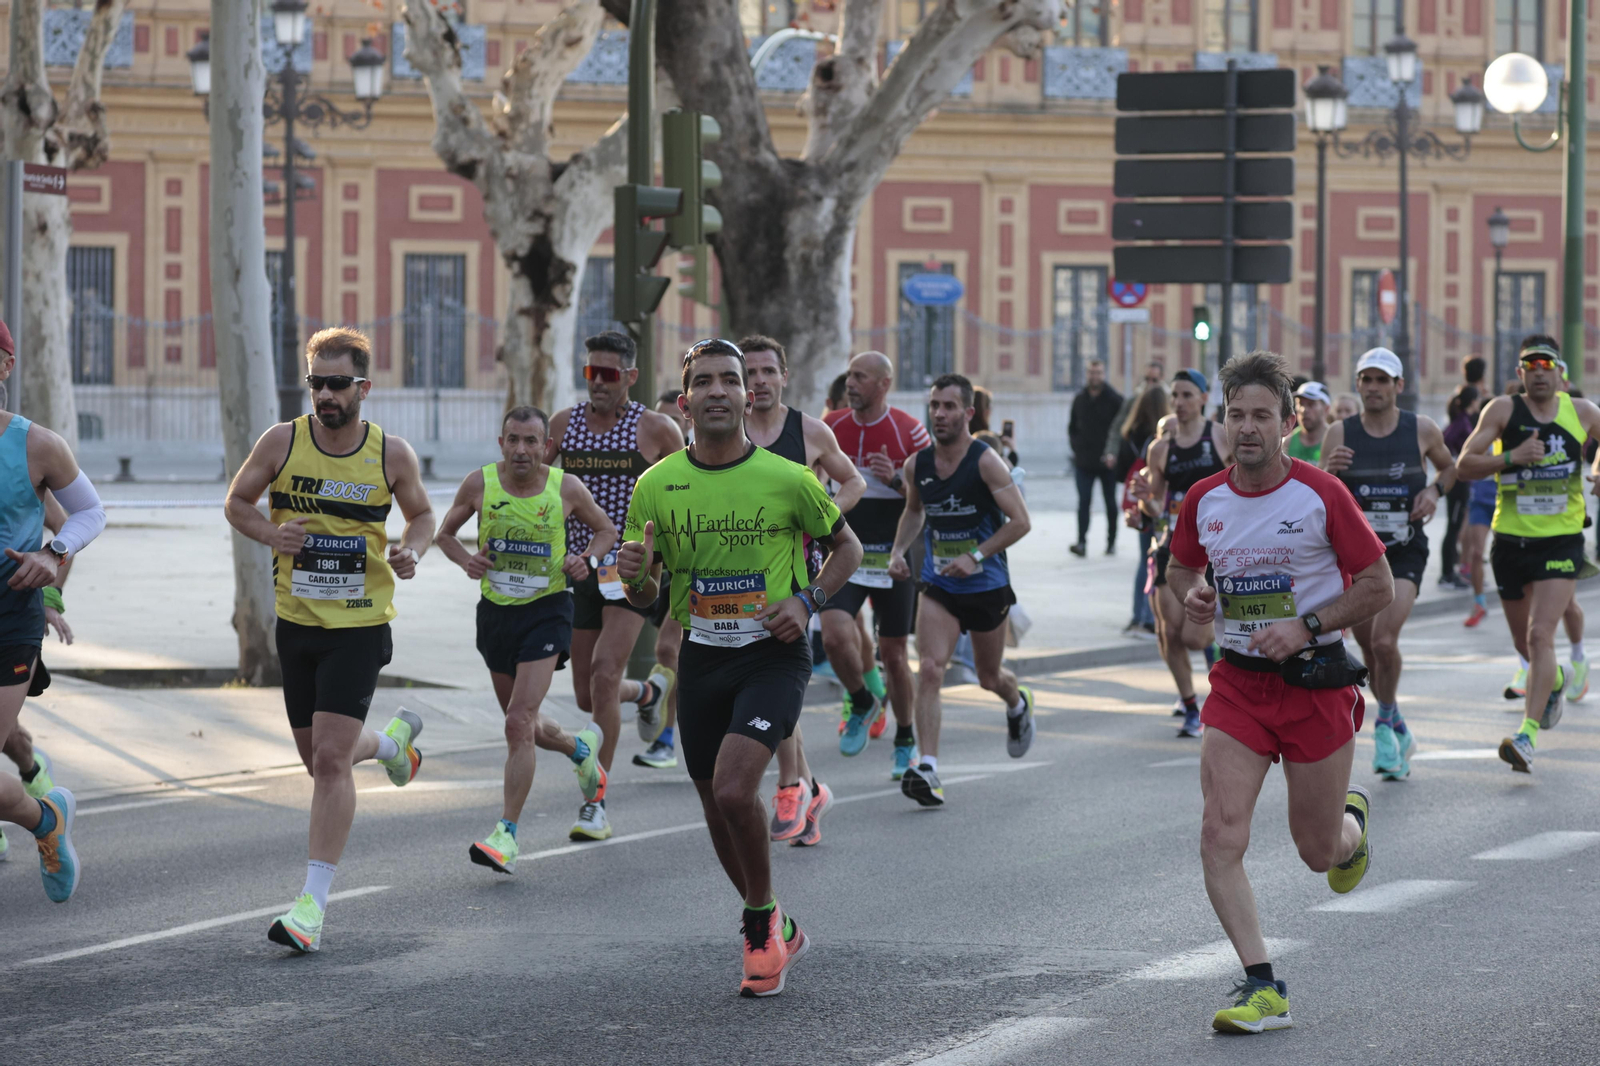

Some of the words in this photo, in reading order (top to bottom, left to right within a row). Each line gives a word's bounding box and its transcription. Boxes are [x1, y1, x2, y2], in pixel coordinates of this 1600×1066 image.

[291, 475, 378, 503] TRIBOOST
[1372, 487, 1402, 495] ZURICH
[696, 506, 765, 532] Fartleck
[1208, 519, 1224, 534] edp
[719, 531, 765, 552] Sport
[941, 532, 970, 540] ZURICH
[316, 538, 358, 549] ZURICH
[508, 543, 544, 554] ZURICH
[1224, 548, 1250, 556] MEDIO
[1252, 546, 1294, 555] MARATÓN
[316, 559, 340, 570] 1981
[508, 561, 528, 571] 1221
[1214, 557, 1228, 567] DE
[1236, 556, 1291, 567] SEVILLA
[308, 575, 340, 584] CARLOS
[342, 576, 348, 584] V
[509, 575, 525, 584] RUIZ
[708, 579, 755, 593] ZURICH
[1236, 580, 1281, 591] ZURICH
[346, 599, 373, 608] 226ERS
[710, 604, 739, 615] 3886
[1240, 604, 1266, 616] 1467
[714, 619, 740, 630] BABÁ
[1239, 621, 1256, 632] JOSÉ
